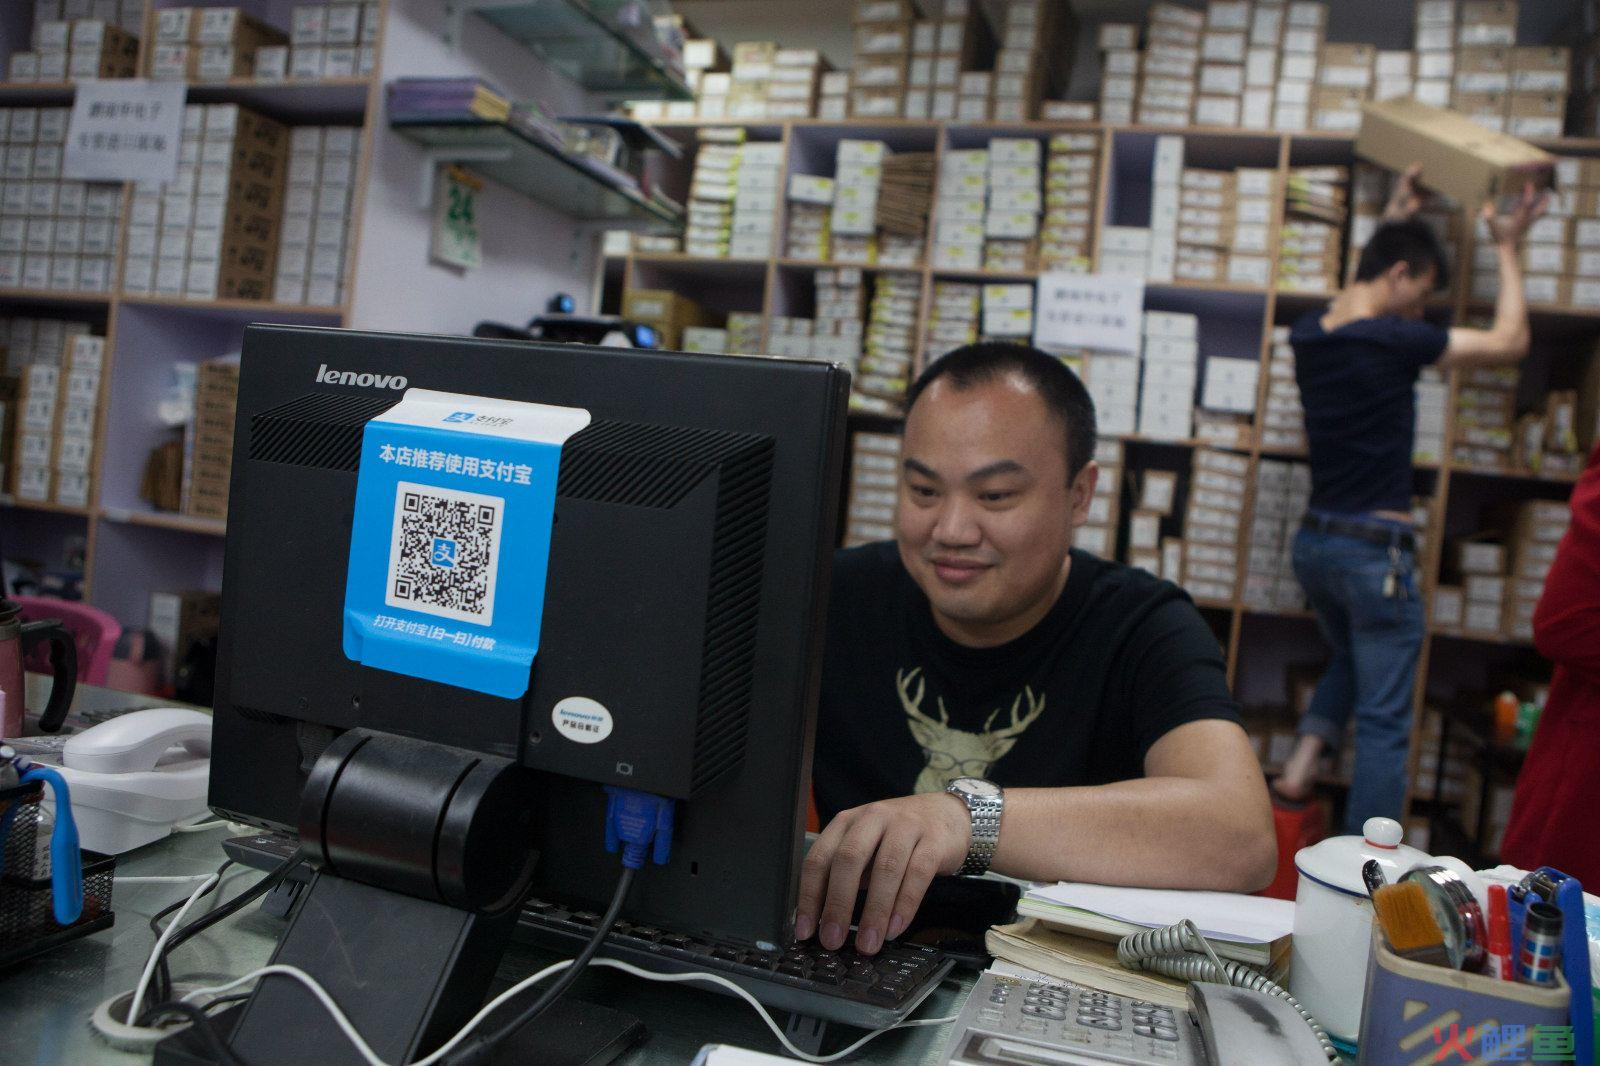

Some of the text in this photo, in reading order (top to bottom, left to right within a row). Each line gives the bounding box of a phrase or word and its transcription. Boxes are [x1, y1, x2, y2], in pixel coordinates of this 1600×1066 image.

[315, 364, 408, 390] lenovo
[379, 443, 533, 485] 本店推荐使用支付宝
